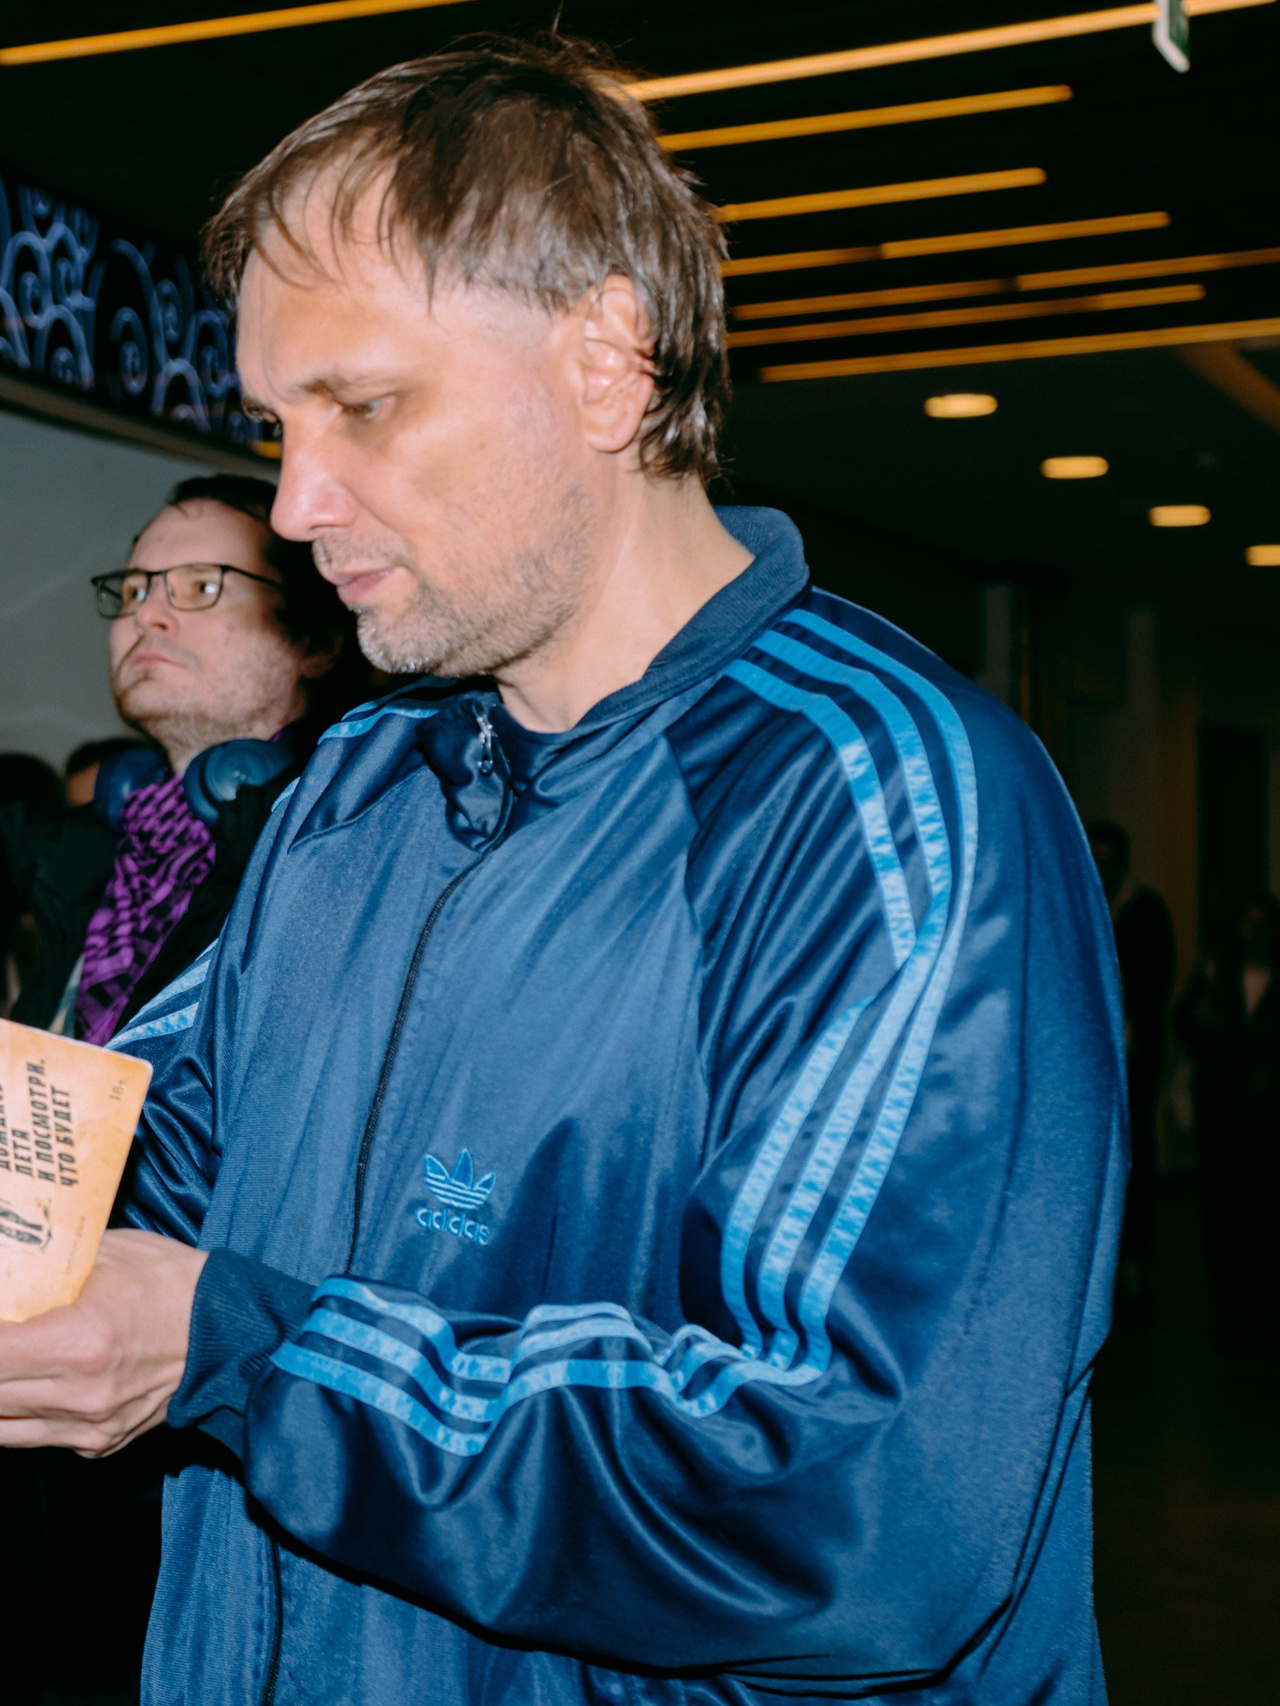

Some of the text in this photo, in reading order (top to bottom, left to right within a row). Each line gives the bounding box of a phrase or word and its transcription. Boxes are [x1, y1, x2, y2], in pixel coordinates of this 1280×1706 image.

[50, 1084, 75, 1148] БУДЕТ
[11, 1127, 34, 1179] ЛЕТА
[58, 1152, 80, 1188] ЧТО
[37, 1169, 57, 1184] И
[416, 1208, 490, 1246] adidas
